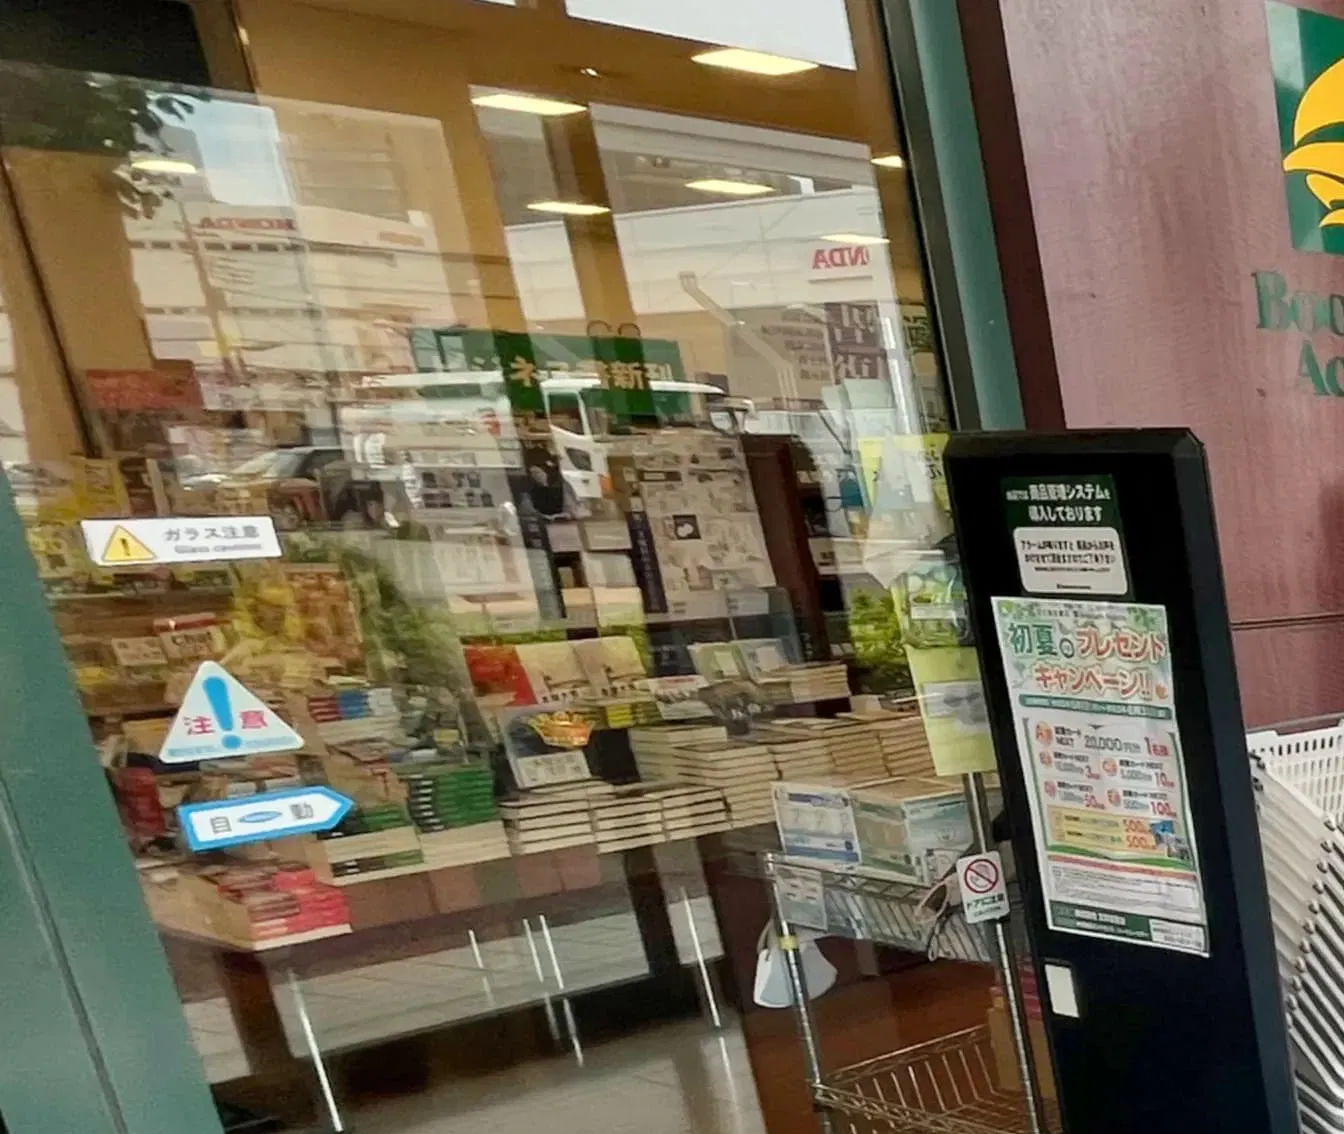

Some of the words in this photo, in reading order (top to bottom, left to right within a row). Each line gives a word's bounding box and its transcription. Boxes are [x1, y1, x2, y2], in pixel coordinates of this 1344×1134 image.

[164, 525, 260, 541] ガラス注意
